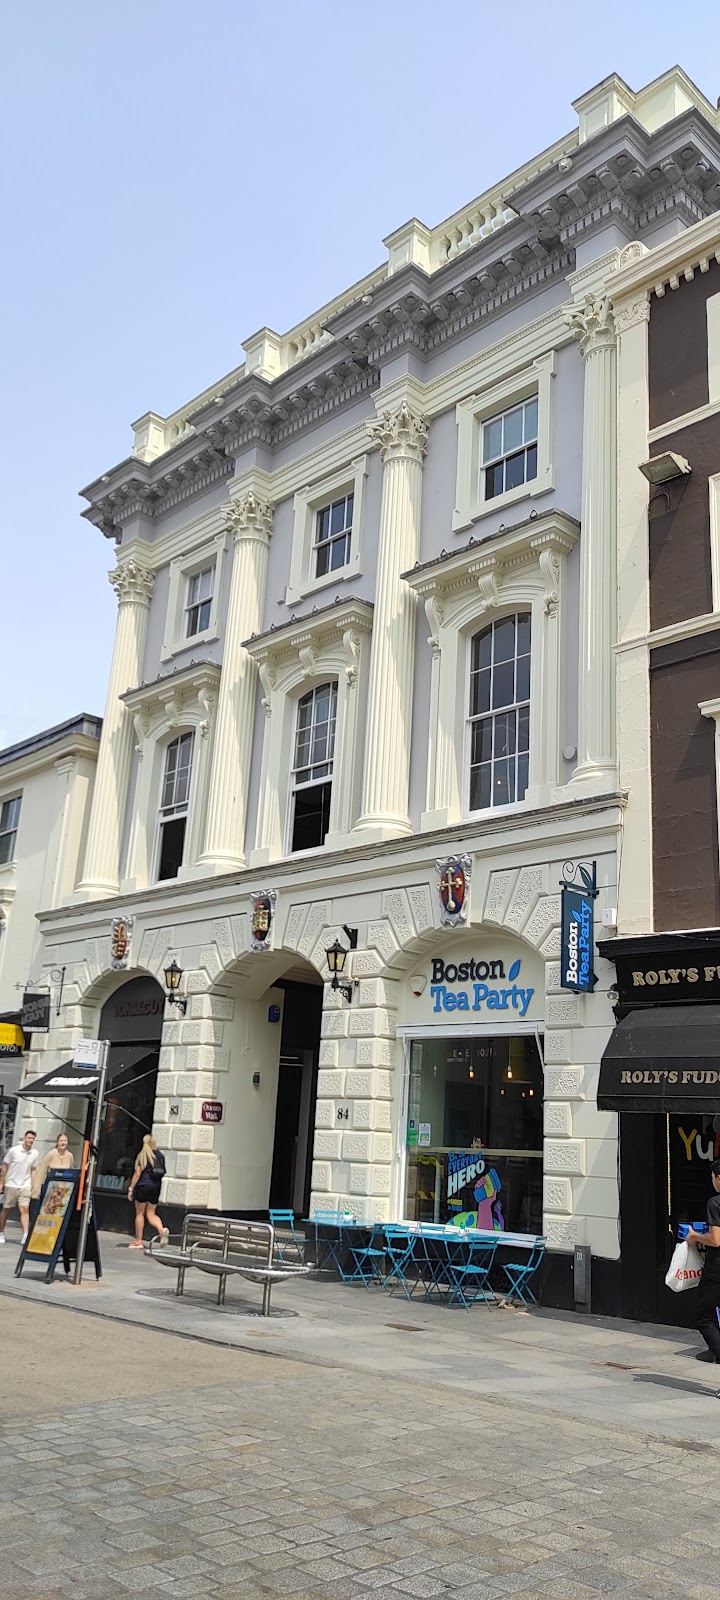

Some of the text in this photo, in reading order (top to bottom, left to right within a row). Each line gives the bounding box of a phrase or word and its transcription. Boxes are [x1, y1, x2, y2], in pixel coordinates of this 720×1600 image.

[566, 922, 578, 984] Boston
[579, 900, 592, 985] Tea Party
[430, 957, 506, 985] Boston
[632, 967, 700, 987] ROLY'S
[430, 983, 535, 1017] Tea Party
[621, 1071, 720, 1084] ROLY'S FUD
[170, 1105, 179, 1115] 83
[337, 1107, 349, 1120] 84
[447, 1160, 486, 1198] HERO
